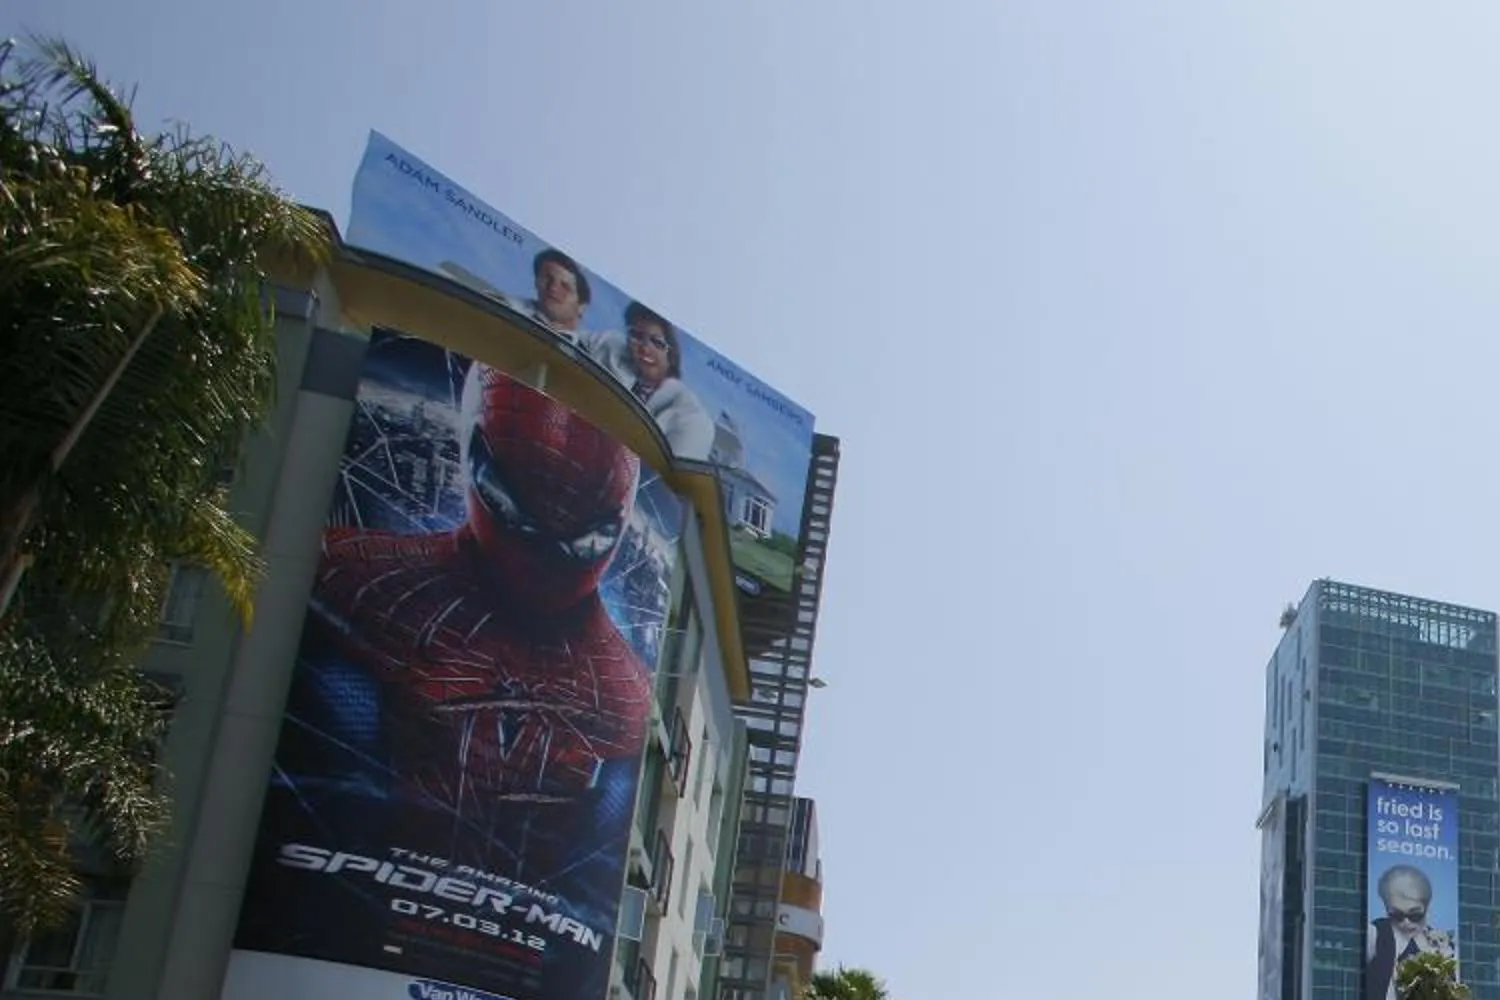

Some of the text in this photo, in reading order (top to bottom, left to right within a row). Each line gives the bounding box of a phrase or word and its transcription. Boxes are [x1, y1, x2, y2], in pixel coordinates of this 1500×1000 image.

[384, 152, 525, 245] ADAM SANDLER
[1377, 796, 1443, 821] fried is
[1377, 819, 1440, 840] so last
[1377, 838, 1453, 860] season.
[276, 843, 603, 952] SPIDER-MAN
[390, 847, 560, 904] THE AMAZING
[391, 899, 547, 951] 07.03.12
